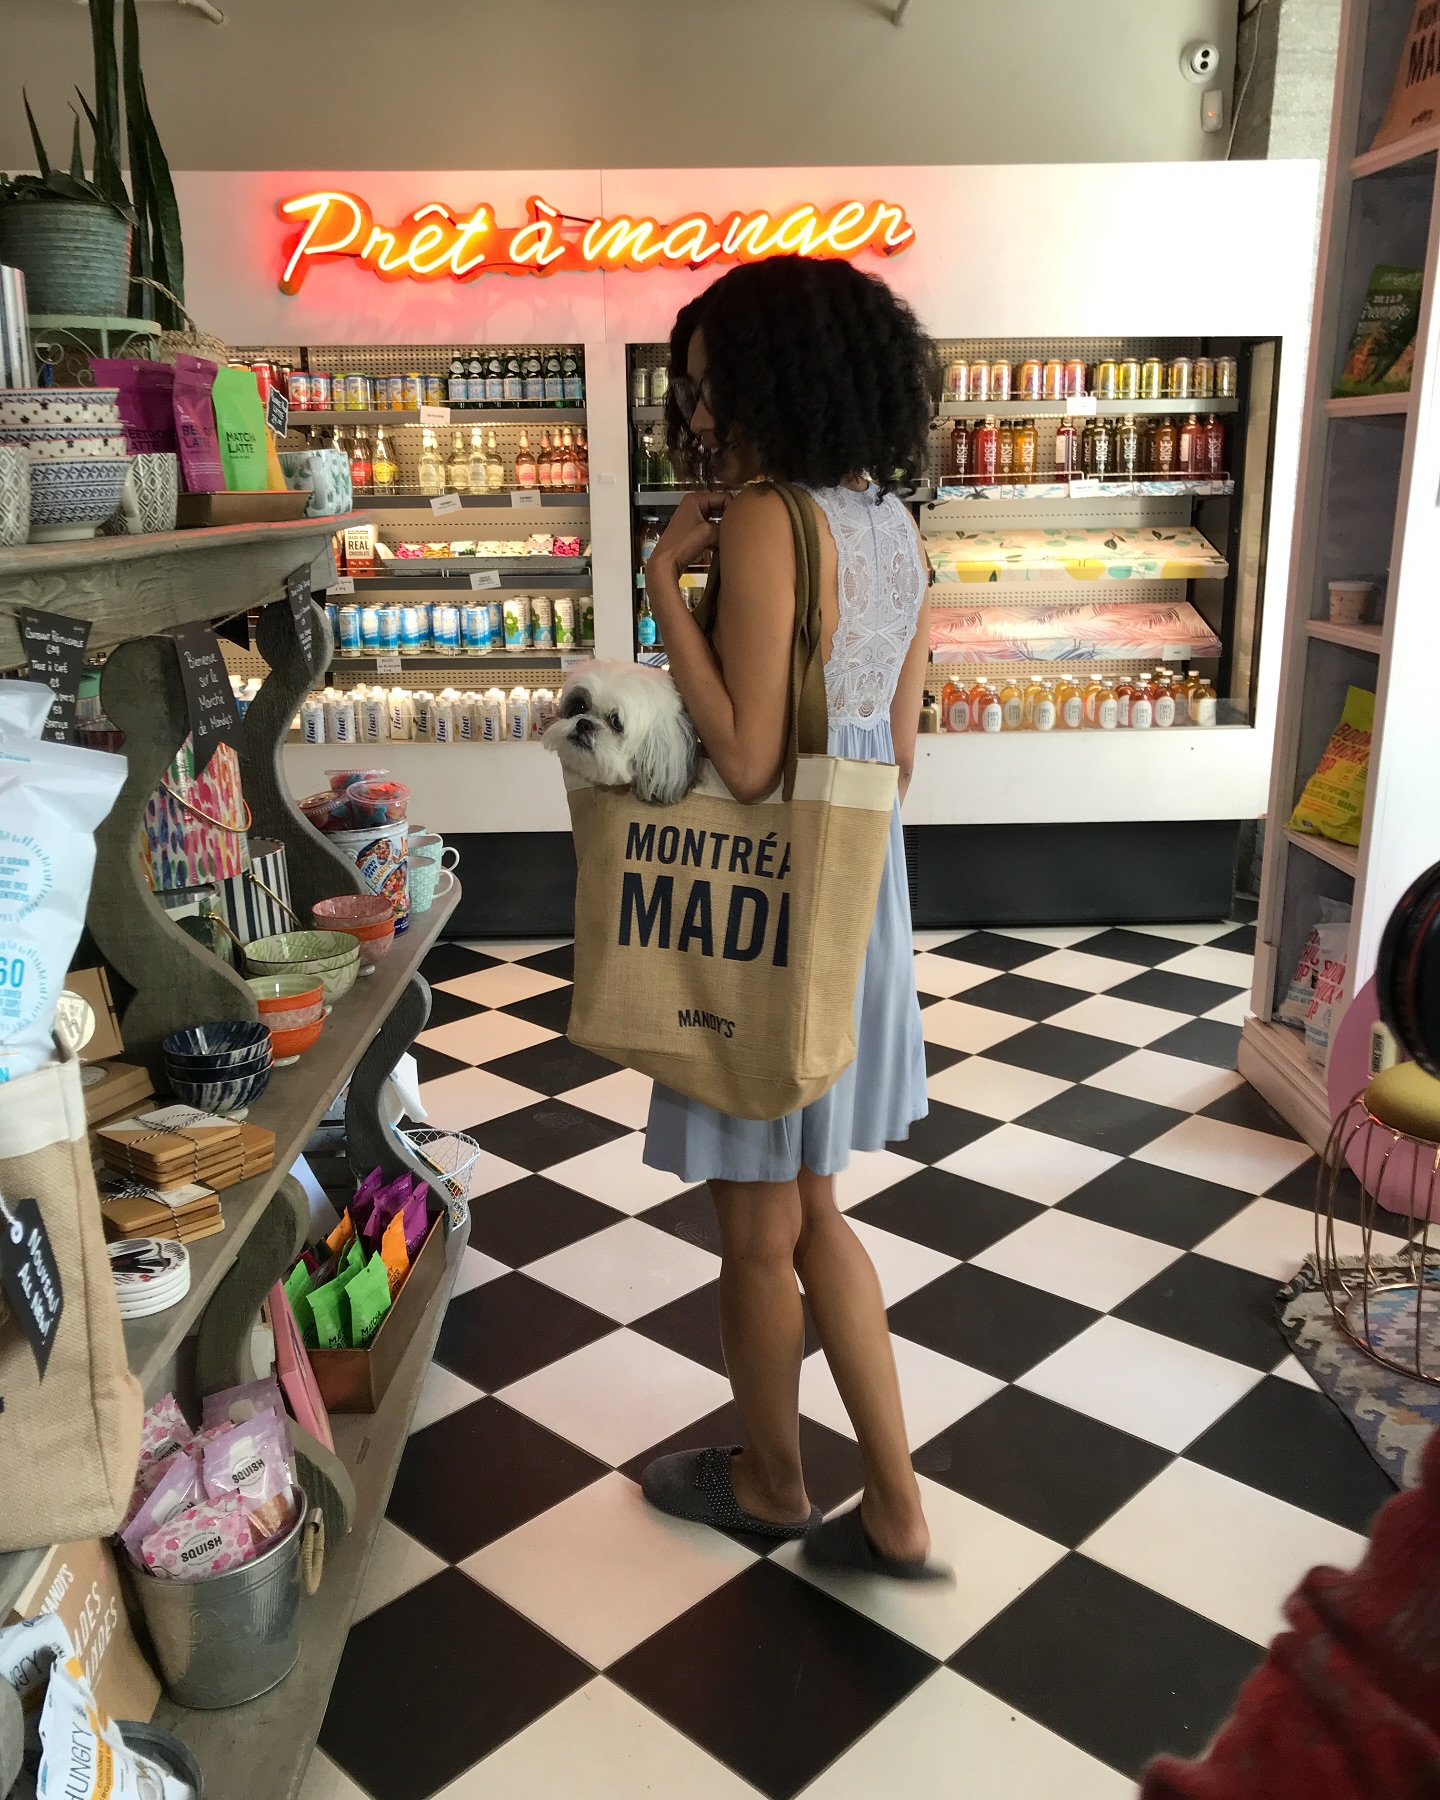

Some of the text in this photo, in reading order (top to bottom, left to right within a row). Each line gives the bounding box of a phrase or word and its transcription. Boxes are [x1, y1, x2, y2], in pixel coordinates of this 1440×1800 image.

[281, 190, 914, 283] Prêt à manger
[227, 443, 255, 455] LATTE
[957, 444, 968, 464] RISE
[985, 441, 997, 463] RISE
[1001, 444, 1013, 464] RISE
[1022, 442, 1035, 463] RISE
[1096, 439, 1108, 461] RISE
[1124, 438, 1137, 460] RISE
[1160, 440, 1173, 461] RISE
[1208, 438, 1222, 459] RISE
[348, 540, 370, 551] REAL
[198, 720, 208, 736] de
[513, 715, 522, 739] flow
[678, 1009, 736, 1039] MANDY'S
[361, 1310, 382, 1336] MATCHA
[231, 1458, 266, 1484] SQUISH
[181, 1535, 223, 1564] SQUISH
